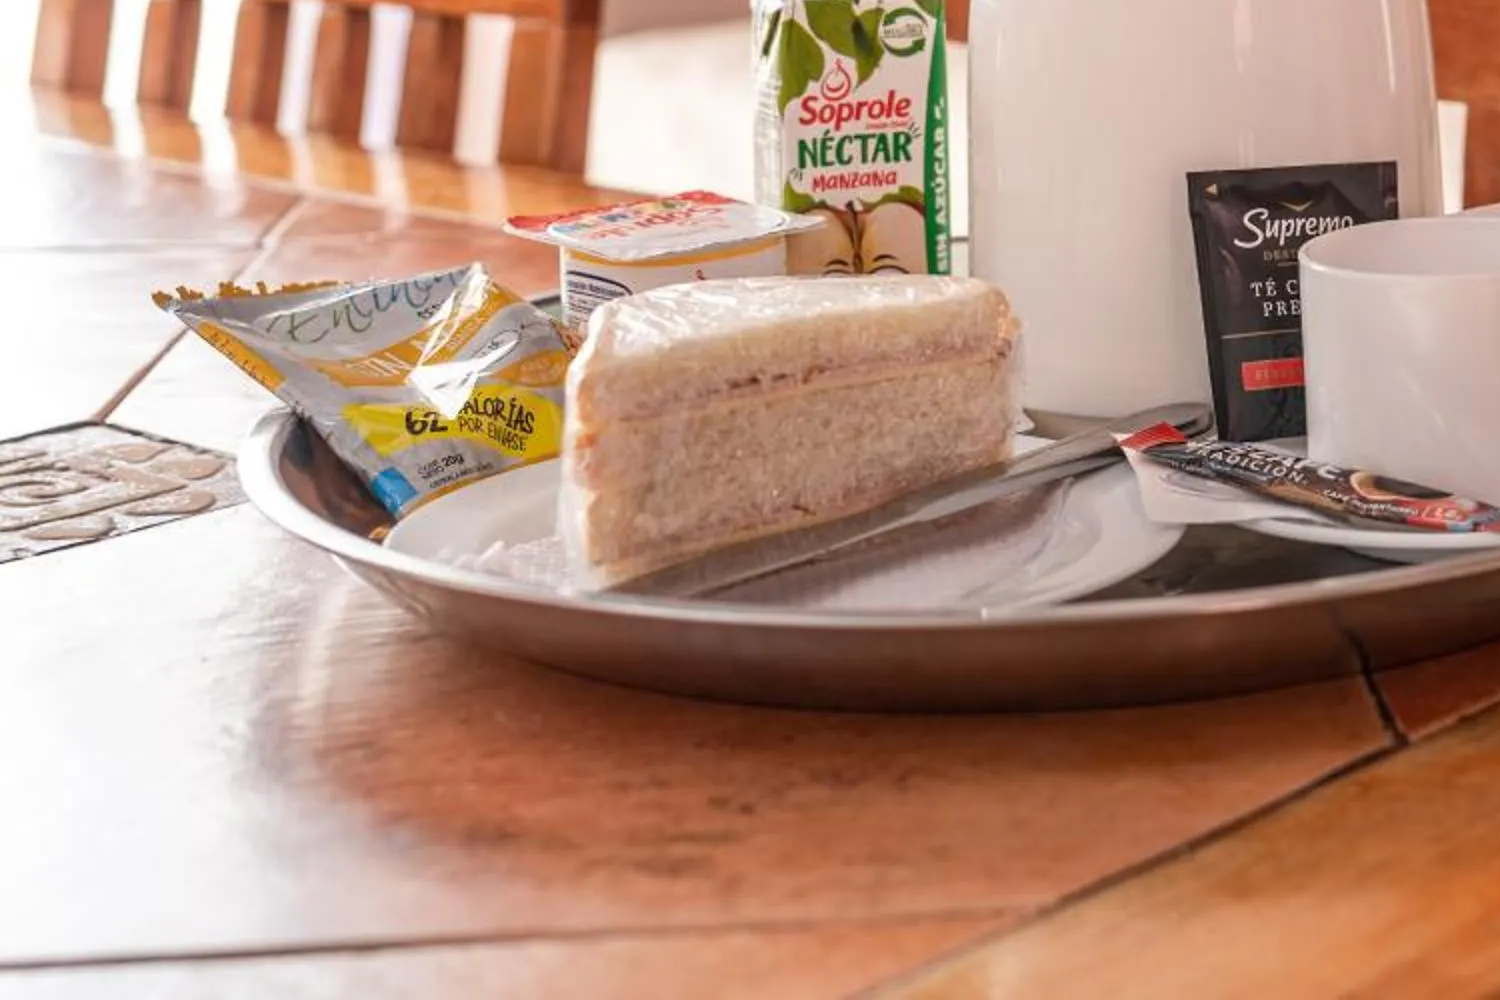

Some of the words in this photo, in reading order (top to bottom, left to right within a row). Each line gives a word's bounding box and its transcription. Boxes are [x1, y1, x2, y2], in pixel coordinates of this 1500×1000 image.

[799, 89, 911, 131] Soprole
[798, 129, 913, 168] NÉCTAR
[1233, 208, 1353, 249] Supremo
[1251, 277, 1277, 298] TÉ
[1263, 299, 1302, 317] PRE
[405, 409, 448, 435] 62
[459, 397, 535, 434] ALORÍAS
[459, 416, 483, 432] POR
